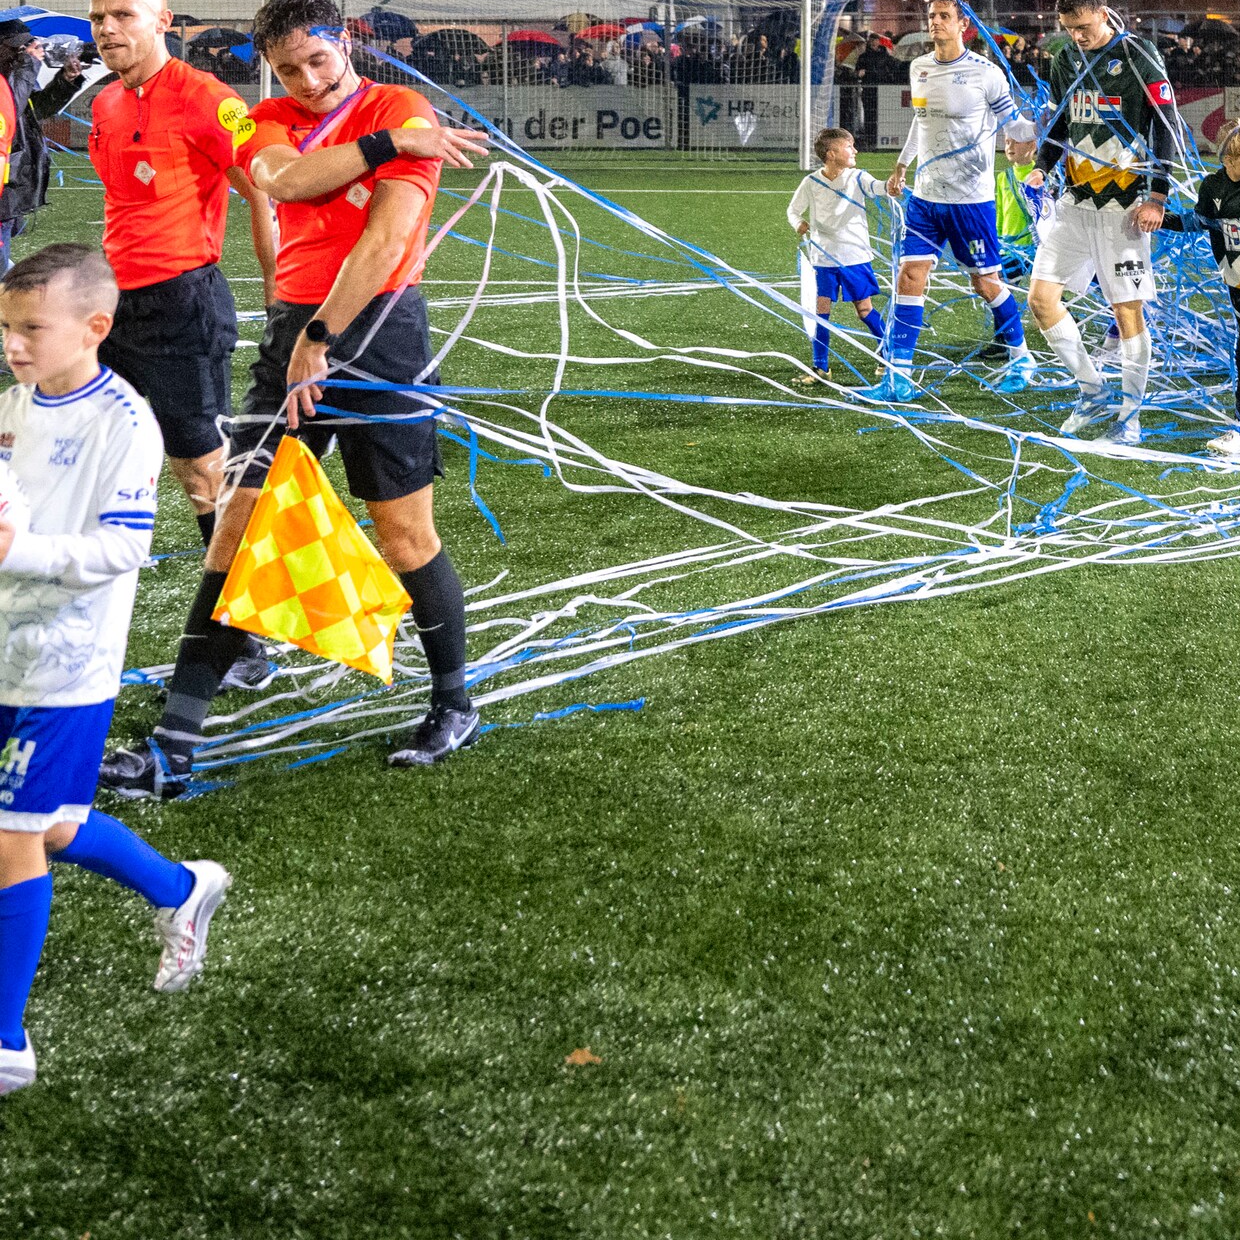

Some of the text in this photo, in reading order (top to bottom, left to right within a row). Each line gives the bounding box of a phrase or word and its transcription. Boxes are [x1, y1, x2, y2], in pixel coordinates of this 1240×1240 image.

[222, 105, 246, 124] ARAG
[728, 100, 756, 117] HR
[1069, 89, 1106, 125] VDL
[237, 122, 252, 134] AG
[524, 108, 586, 140] der
[1115, 260, 1144, 271] MH
